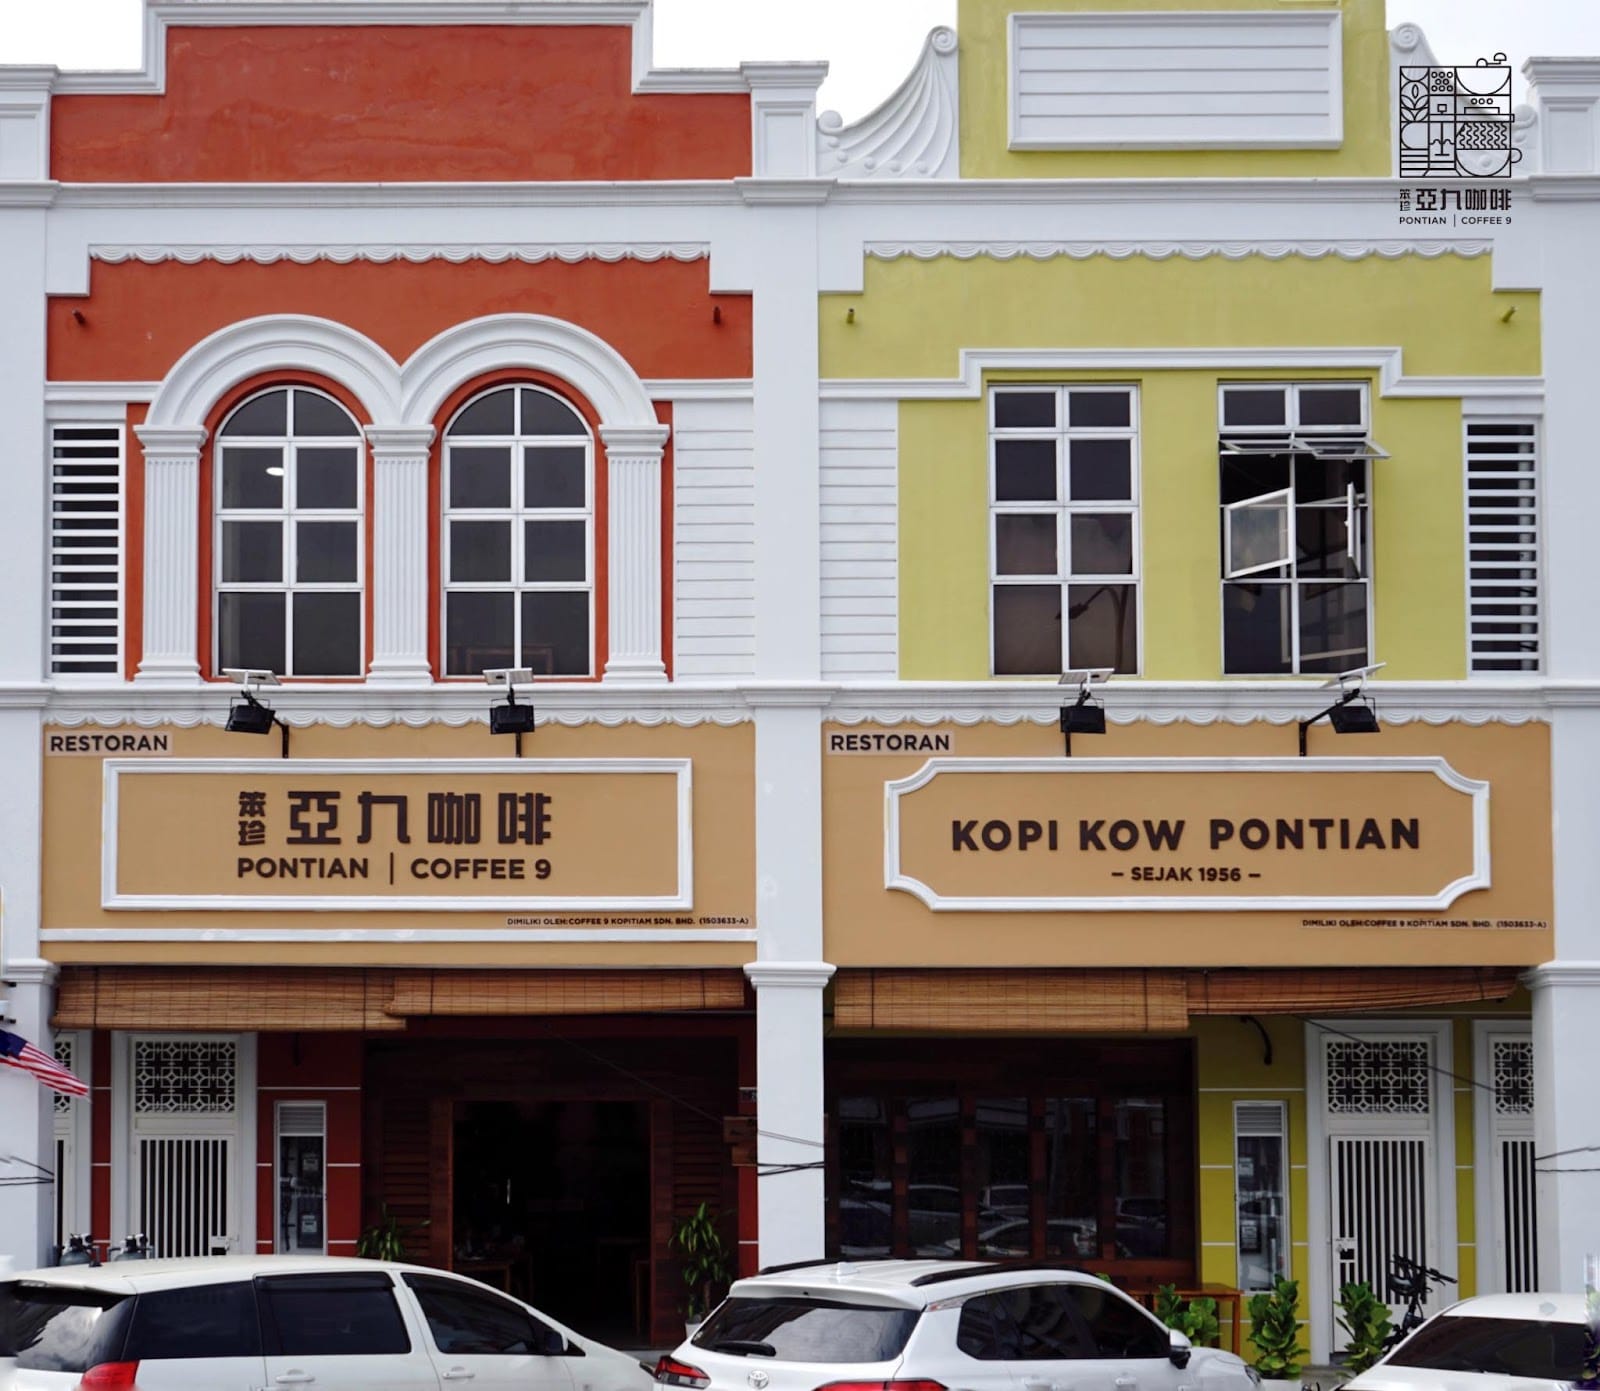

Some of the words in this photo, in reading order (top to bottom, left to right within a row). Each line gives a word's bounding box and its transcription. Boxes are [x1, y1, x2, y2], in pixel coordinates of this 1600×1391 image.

[51, 734, 168, 752] RESTORAN
[831, 734, 950, 752] RESTORAN
[286, 790, 552, 846] 亞九咖啡
[952, 819, 1058, 852] KOPI
[1080, 819, 1186, 852] KOW
[1210, 817, 1420, 851] PONTIAN
[237, 857, 369, 879] PONTIAN
[410, 857, 526, 880] COFFEE
[534, 857, 552, 880] 9
[1131, 866, 1193, 882] SEJAK
[1198, 866, 1242, 882] 1956
[507, 917, 542, 926] DIMILIKI
[611, 917, 652, 926] KOPITIAM
[1302, 919, 1337, 927] DIMILIKI
[1407, 919, 1449, 928] KOPITIAM
